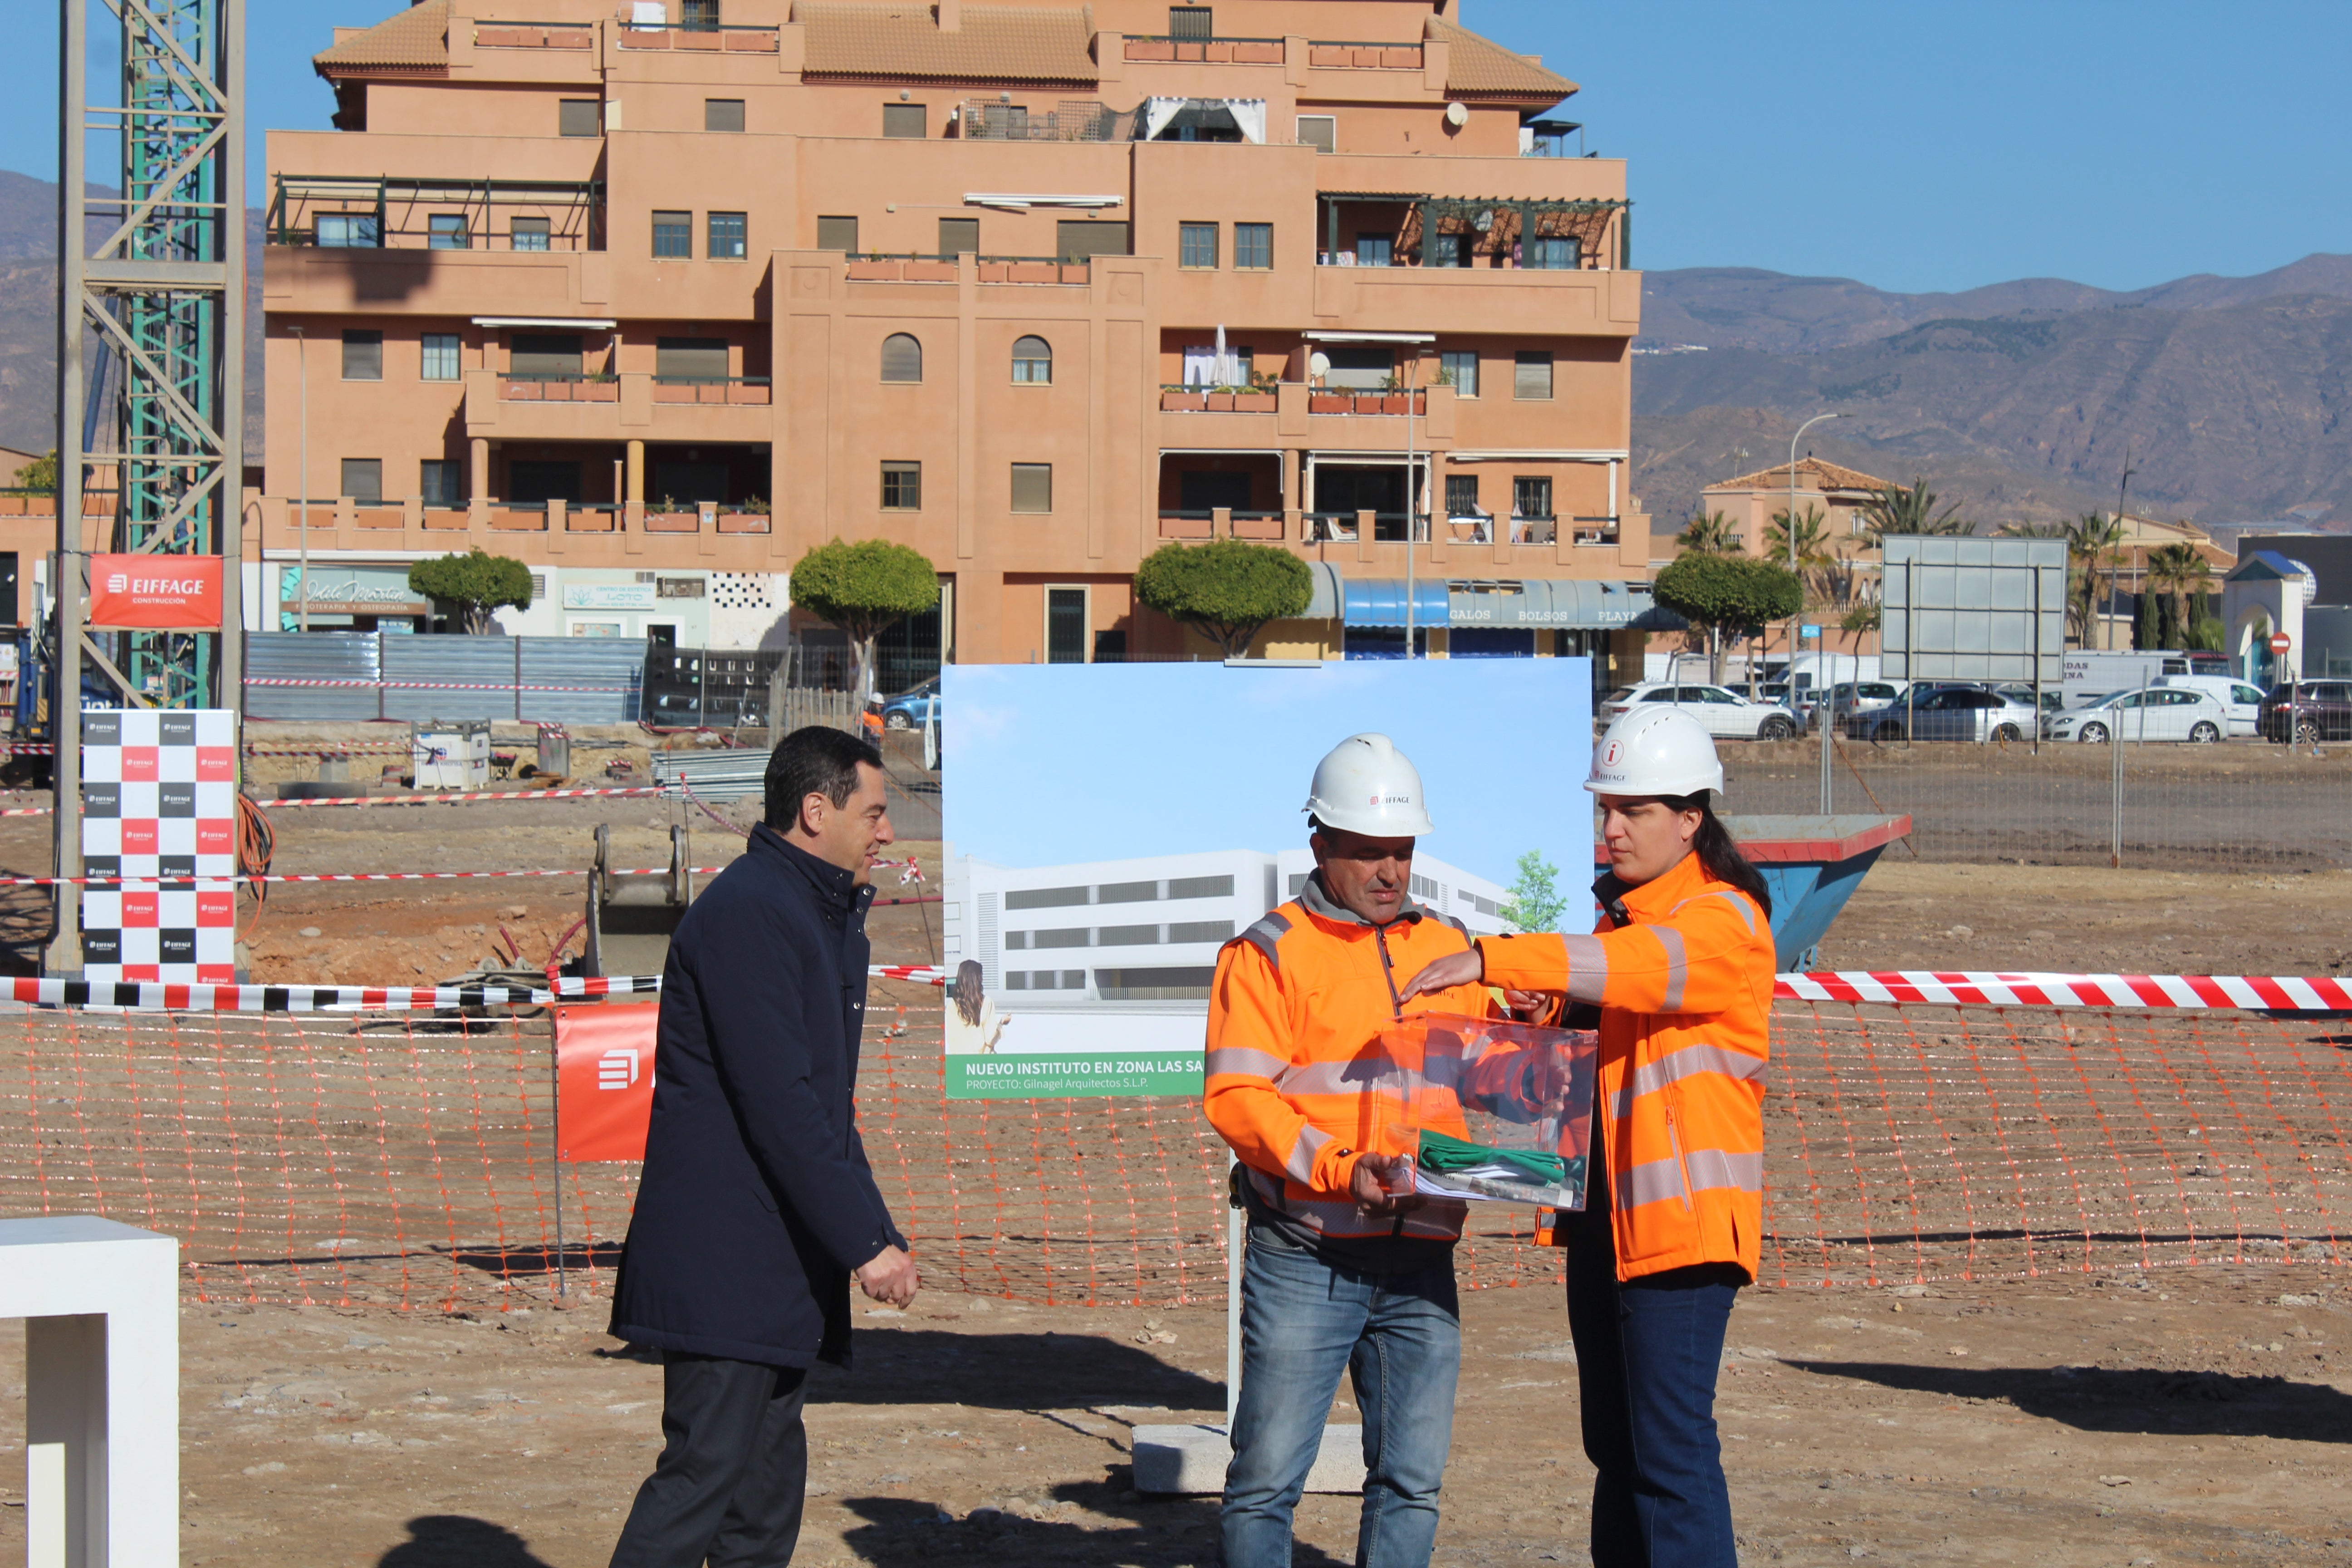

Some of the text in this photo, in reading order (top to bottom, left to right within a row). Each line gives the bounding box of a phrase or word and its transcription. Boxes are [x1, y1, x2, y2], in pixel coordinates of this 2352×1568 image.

[132, 579, 204, 594] EIFFAGE
[1519, 611, 1568, 622] BOLSOS
[1598, 611, 1638, 622] PLAYA
[1600, 773, 1626, 781] EIFFAGE
[966, 1063, 1014, 1075] NUEVO
[1018, 1062, 1091, 1074] INSTITUTO
[1095, 1062, 1112, 1073] EN
[1116, 1061, 1154, 1073] ZONA
[1158, 1060, 1182, 1072] LAS
[967, 1078, 1148, 1091] PROYECTO: Gilnagel Arquitectos S.L.P.
